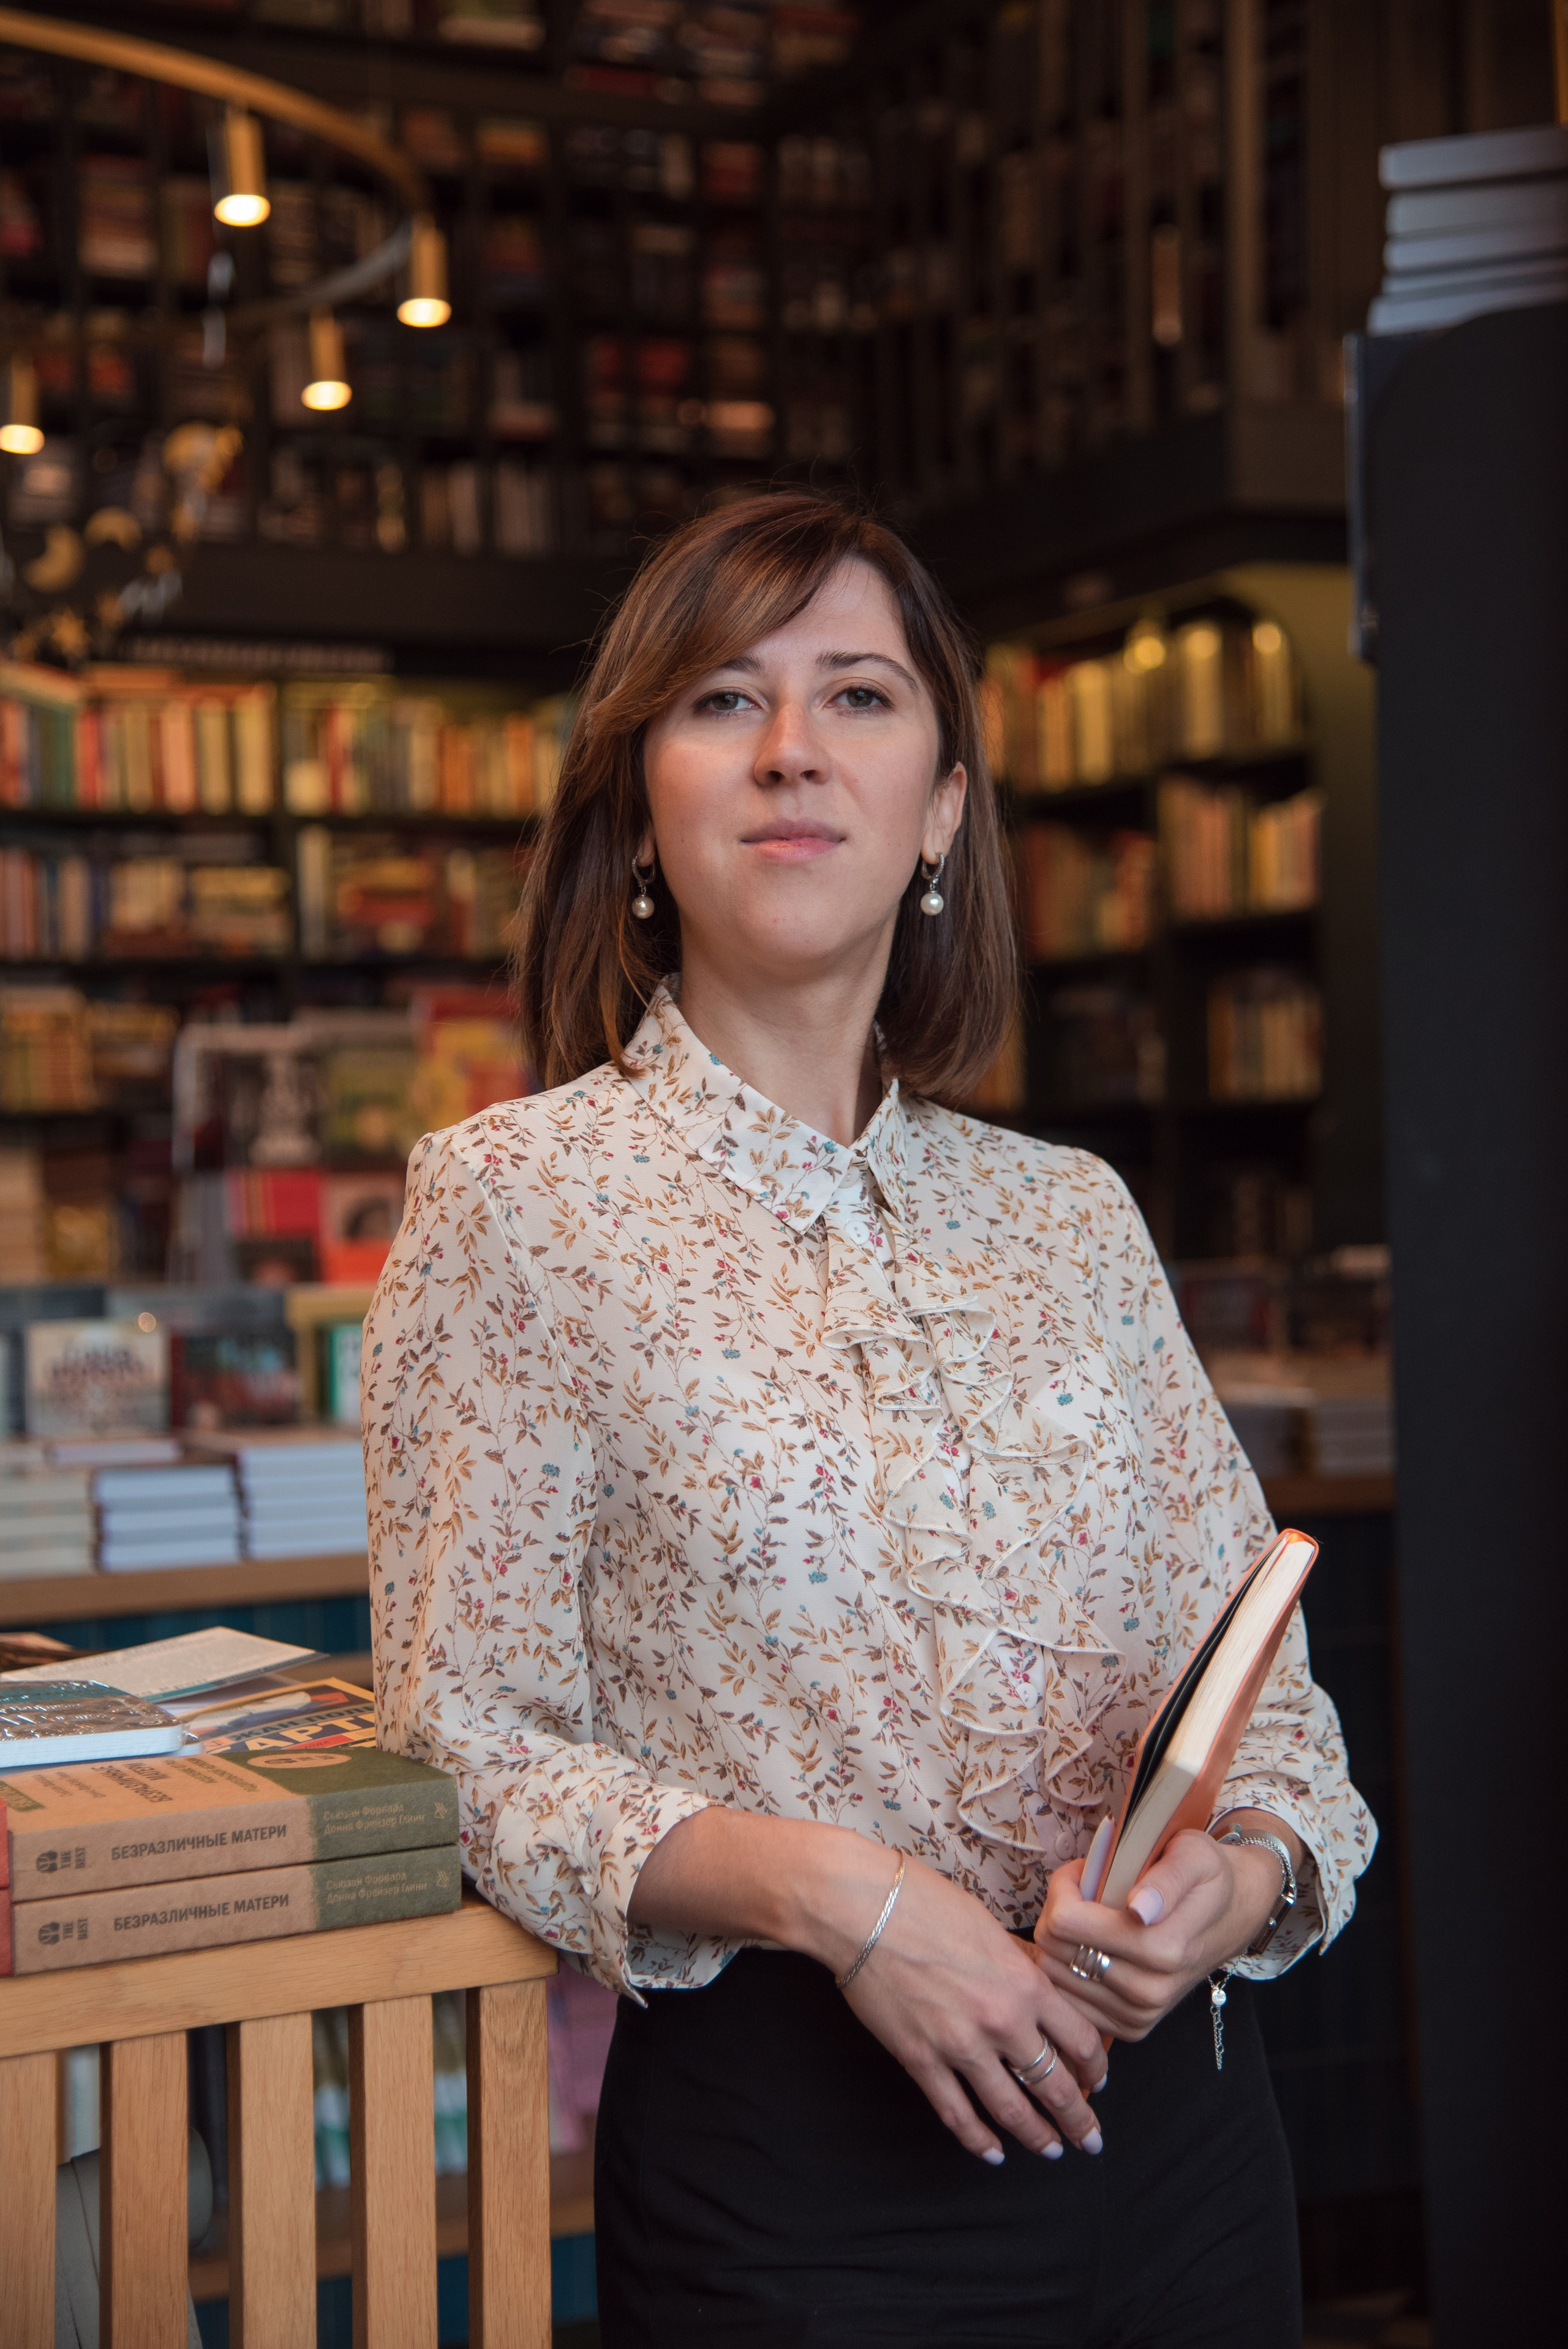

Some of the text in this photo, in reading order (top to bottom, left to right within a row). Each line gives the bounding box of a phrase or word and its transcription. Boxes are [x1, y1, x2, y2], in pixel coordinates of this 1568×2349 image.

[228, 1721, 300, 1741] ЖАН
[123, 1762, 170, 1781] МАТЕРИ
[91, 1765, 173, 1803] БЕЗРАЗЛИЧНЫЕ
[323, 1804, 404, 1821] Сьюзан Форвард
[323, 1823, 353, 1836] Донна
[355, 1816, 397, 1831] Фрейзер
[111, 1824, 287, 1861] БЕЗРАЗЛИЧНЫЕ МАТЕРИ
[326, 1872, 407, 1890] Сьюзан Форвард
[326, 1891, 356, 1905] Донна
[358, 1885, 399, 1899] Фрейзер
[113, 1893, 289, 1931] БЕЗРАЗЛИЧНЫЕ МАТЕРИ
